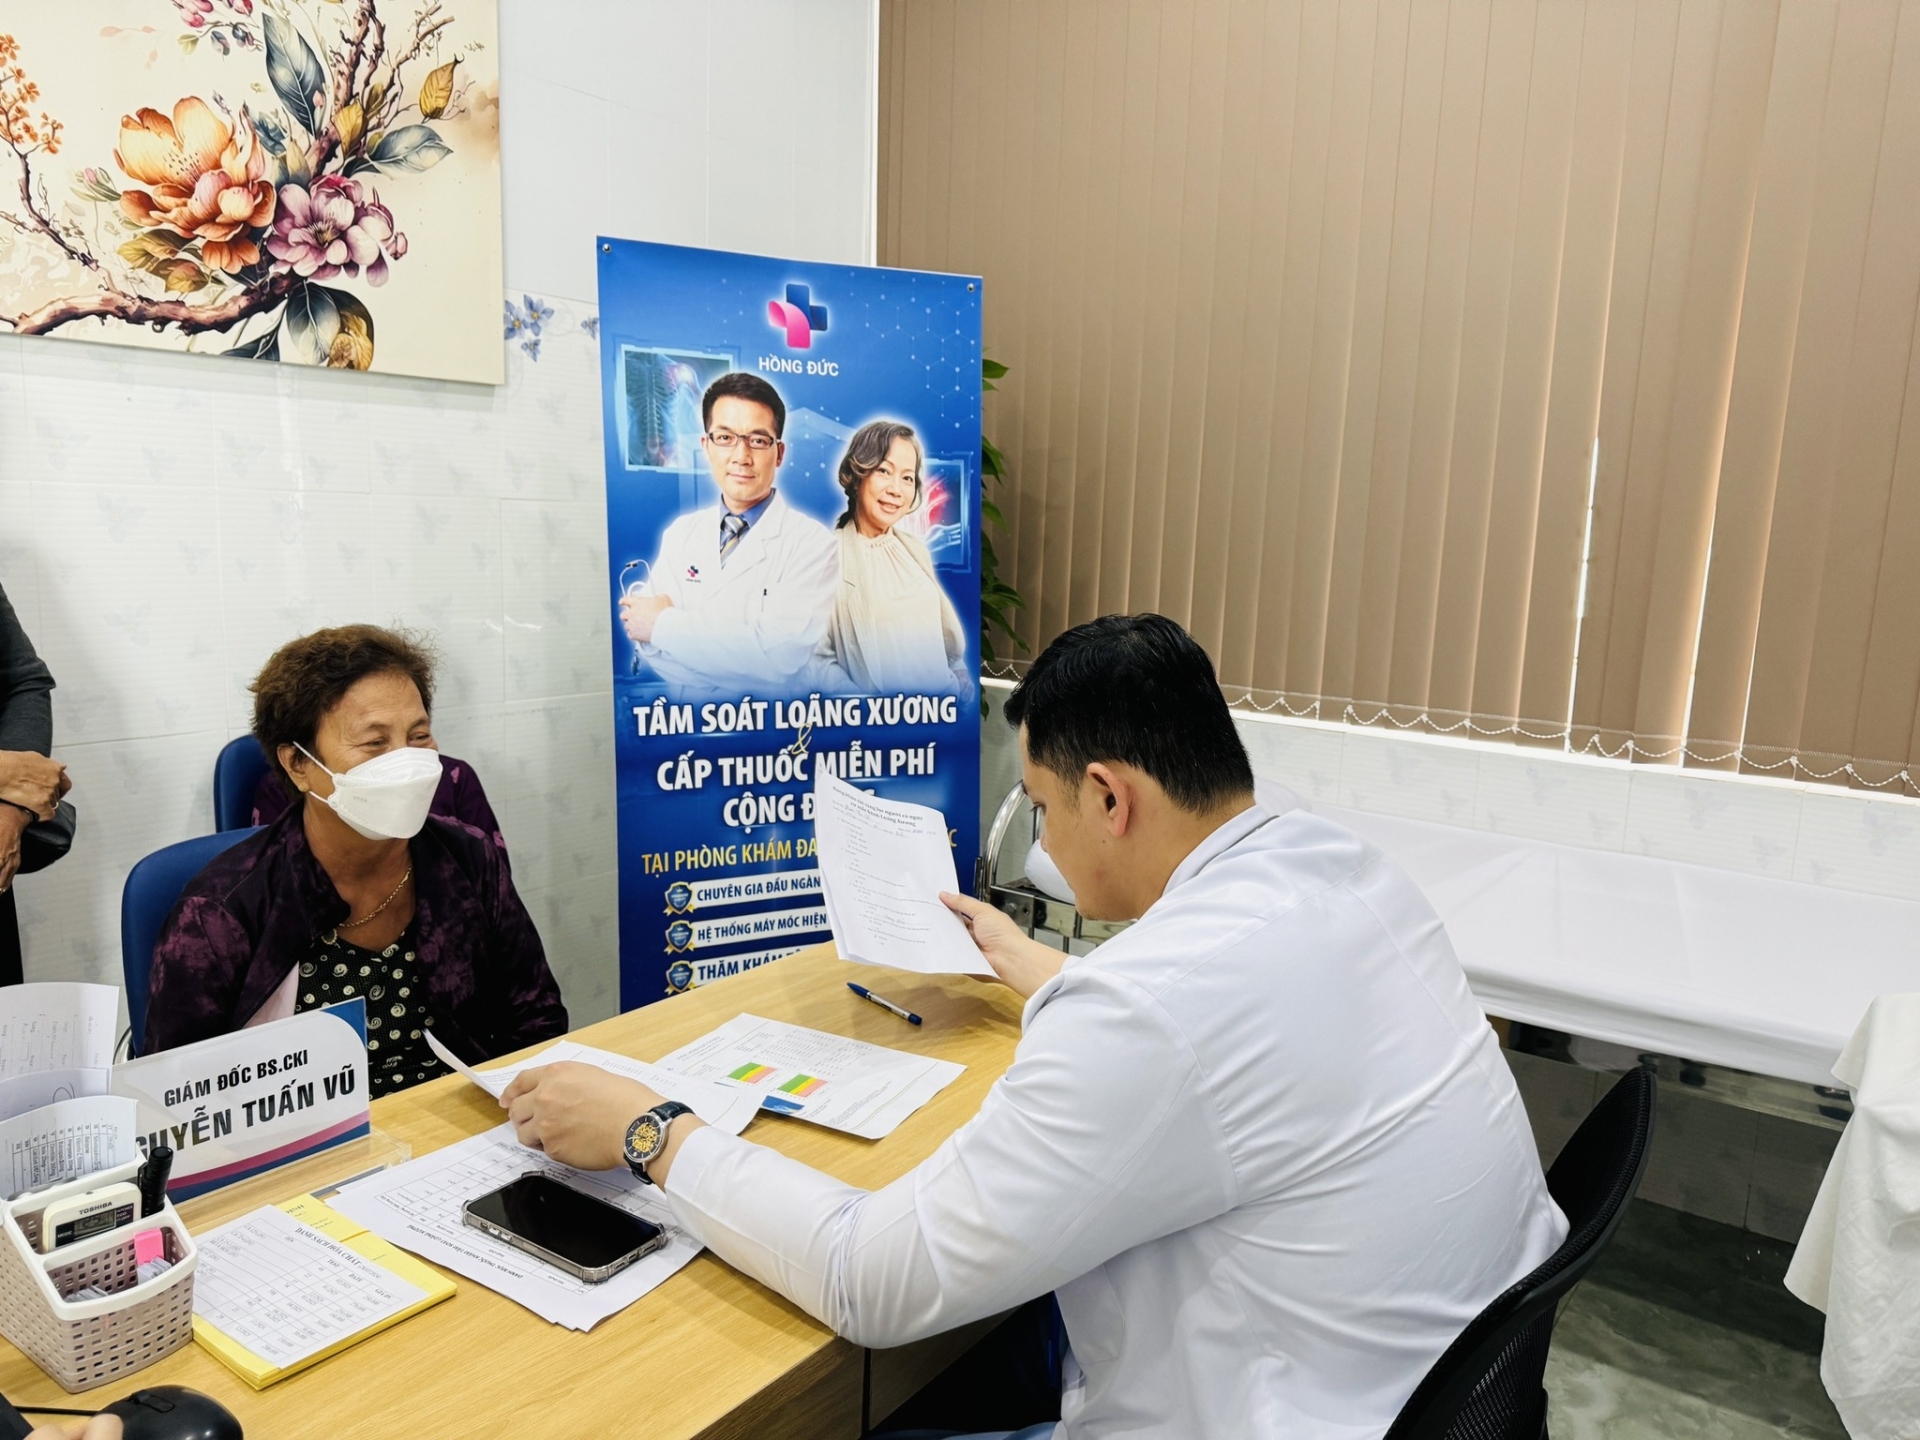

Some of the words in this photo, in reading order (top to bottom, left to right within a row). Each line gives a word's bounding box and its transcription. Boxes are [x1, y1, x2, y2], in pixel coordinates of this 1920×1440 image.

[758, 353, 803, 374] HỒNG
[806, 358, 839, 376] ĐỨC
[633, 696, 694, 736] TẦM
[701, 696, 768, 733] SOÁT
[774, 693, 861, 729] LOÃNG
[867, 694, 957, 726] XƯƠNG
[791, 723, 812, 755] &
[657, 750, 712, 791] CẤP
[718, 745, 808, 787] THUỐC
[815, 740, 882, 779] MIỄN
[890, 742, 936, 776] PHÍ
[723, 791, 795, 834] CỘNG
[641, 852, 669, 878] TẠI
[675, 844, 737, 871] PHÒNG
[742, 838, 792, 864] KHÁM
[697, 883, 742, 901] CHUYÊN
[744, 882, 763, 895] GIA
[698, 929, 712, 943] HỆ
[714, 921, 751, 938] THỐNG
[753, 919, 776, 933] MÁY
[777, 914, 800, 929] MÓC
[802, 912, 827, 928] HIỆN
[698, 959, 739, 980] THĂM
[164, 1079, 210, 1107] GIÁM
[217, 1064, 251, 1091] ĐỐC
[257, 1049, 308, 1079] BS.CKI
[242, 1078, 314, 1127] TUẤN
[323, 1064, 355, 1100] VŨ
[79, 1201, 112, 1215] TOSHIBA
